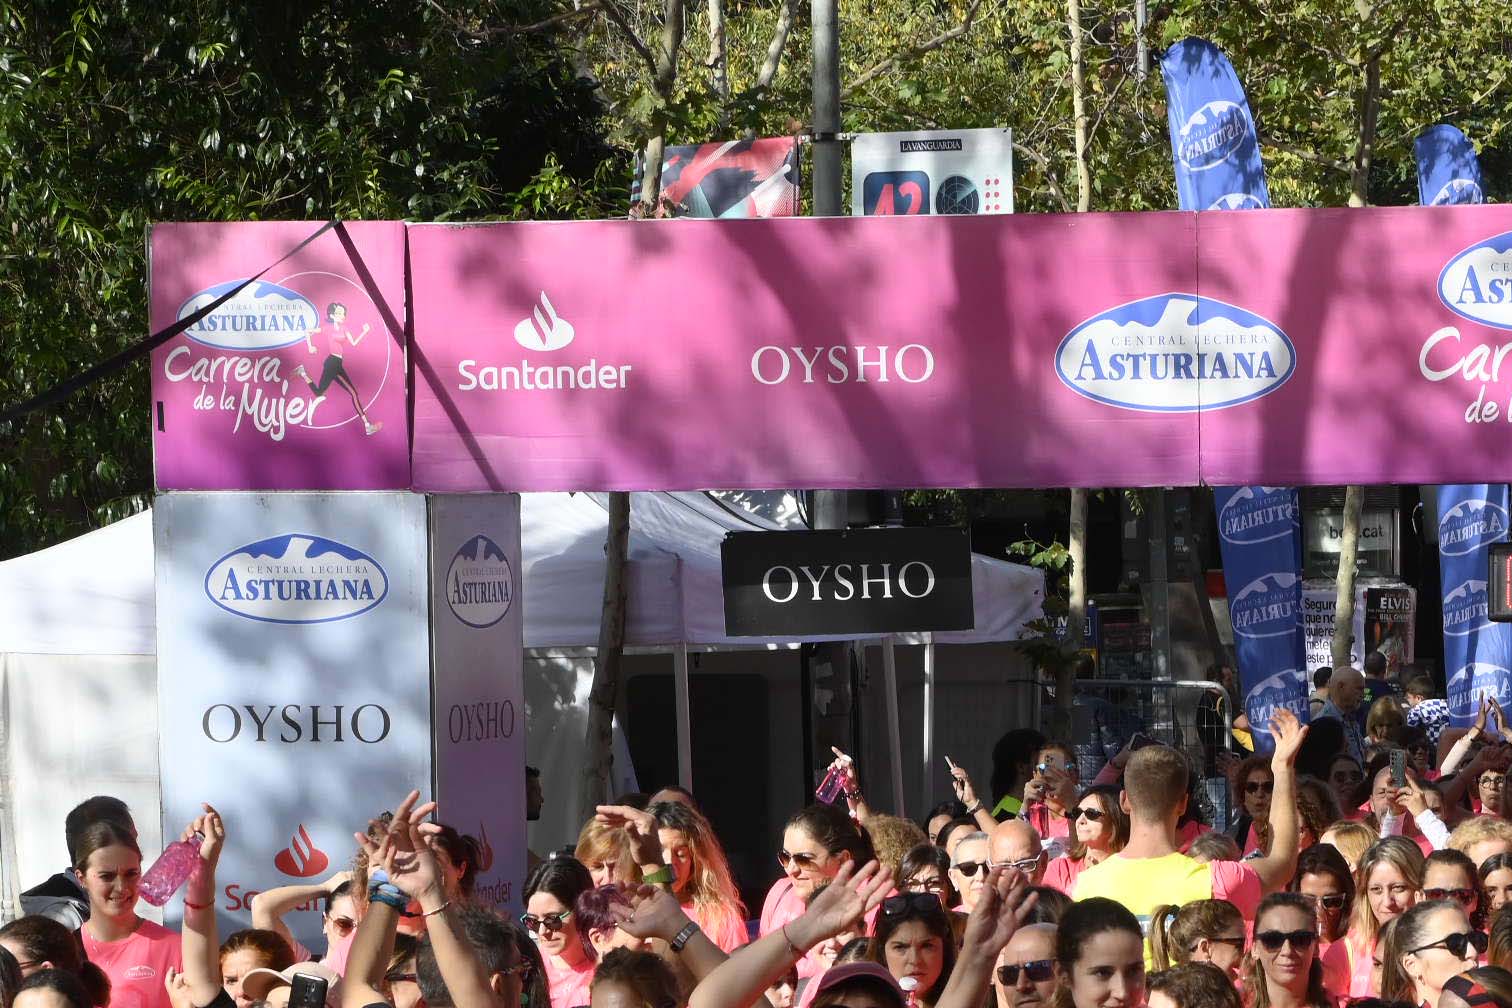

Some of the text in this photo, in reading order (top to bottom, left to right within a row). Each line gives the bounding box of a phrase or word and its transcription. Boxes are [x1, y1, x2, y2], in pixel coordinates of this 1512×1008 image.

[1111, 333, 1269, 346] CENTRAL LECHERA
[165, 346, 282, 383] Carrera
[459, 359, 632, 391] Santander
[750, 343, 935, 386] OYSHO
[1075, 338, 1277, 382] ASTURIANA
[193, 379, 327, 441] de la Mujer
[1465, 383, 1500, 425] de
[221, 567, 375, 602] ASTURIANA
[247, 564, 370, 574] CENTRAL LECHERA
[451, 569, 510, 605] ASTURIANA
[762, 561, 935, 603] OYSHO
[1379, 597, 1410, 609] ELVIS
[1307, 653, 1325, 664] este
[201, 703, 391, 744] OYSHO
[448, 699, 515, 744] OYSHO
